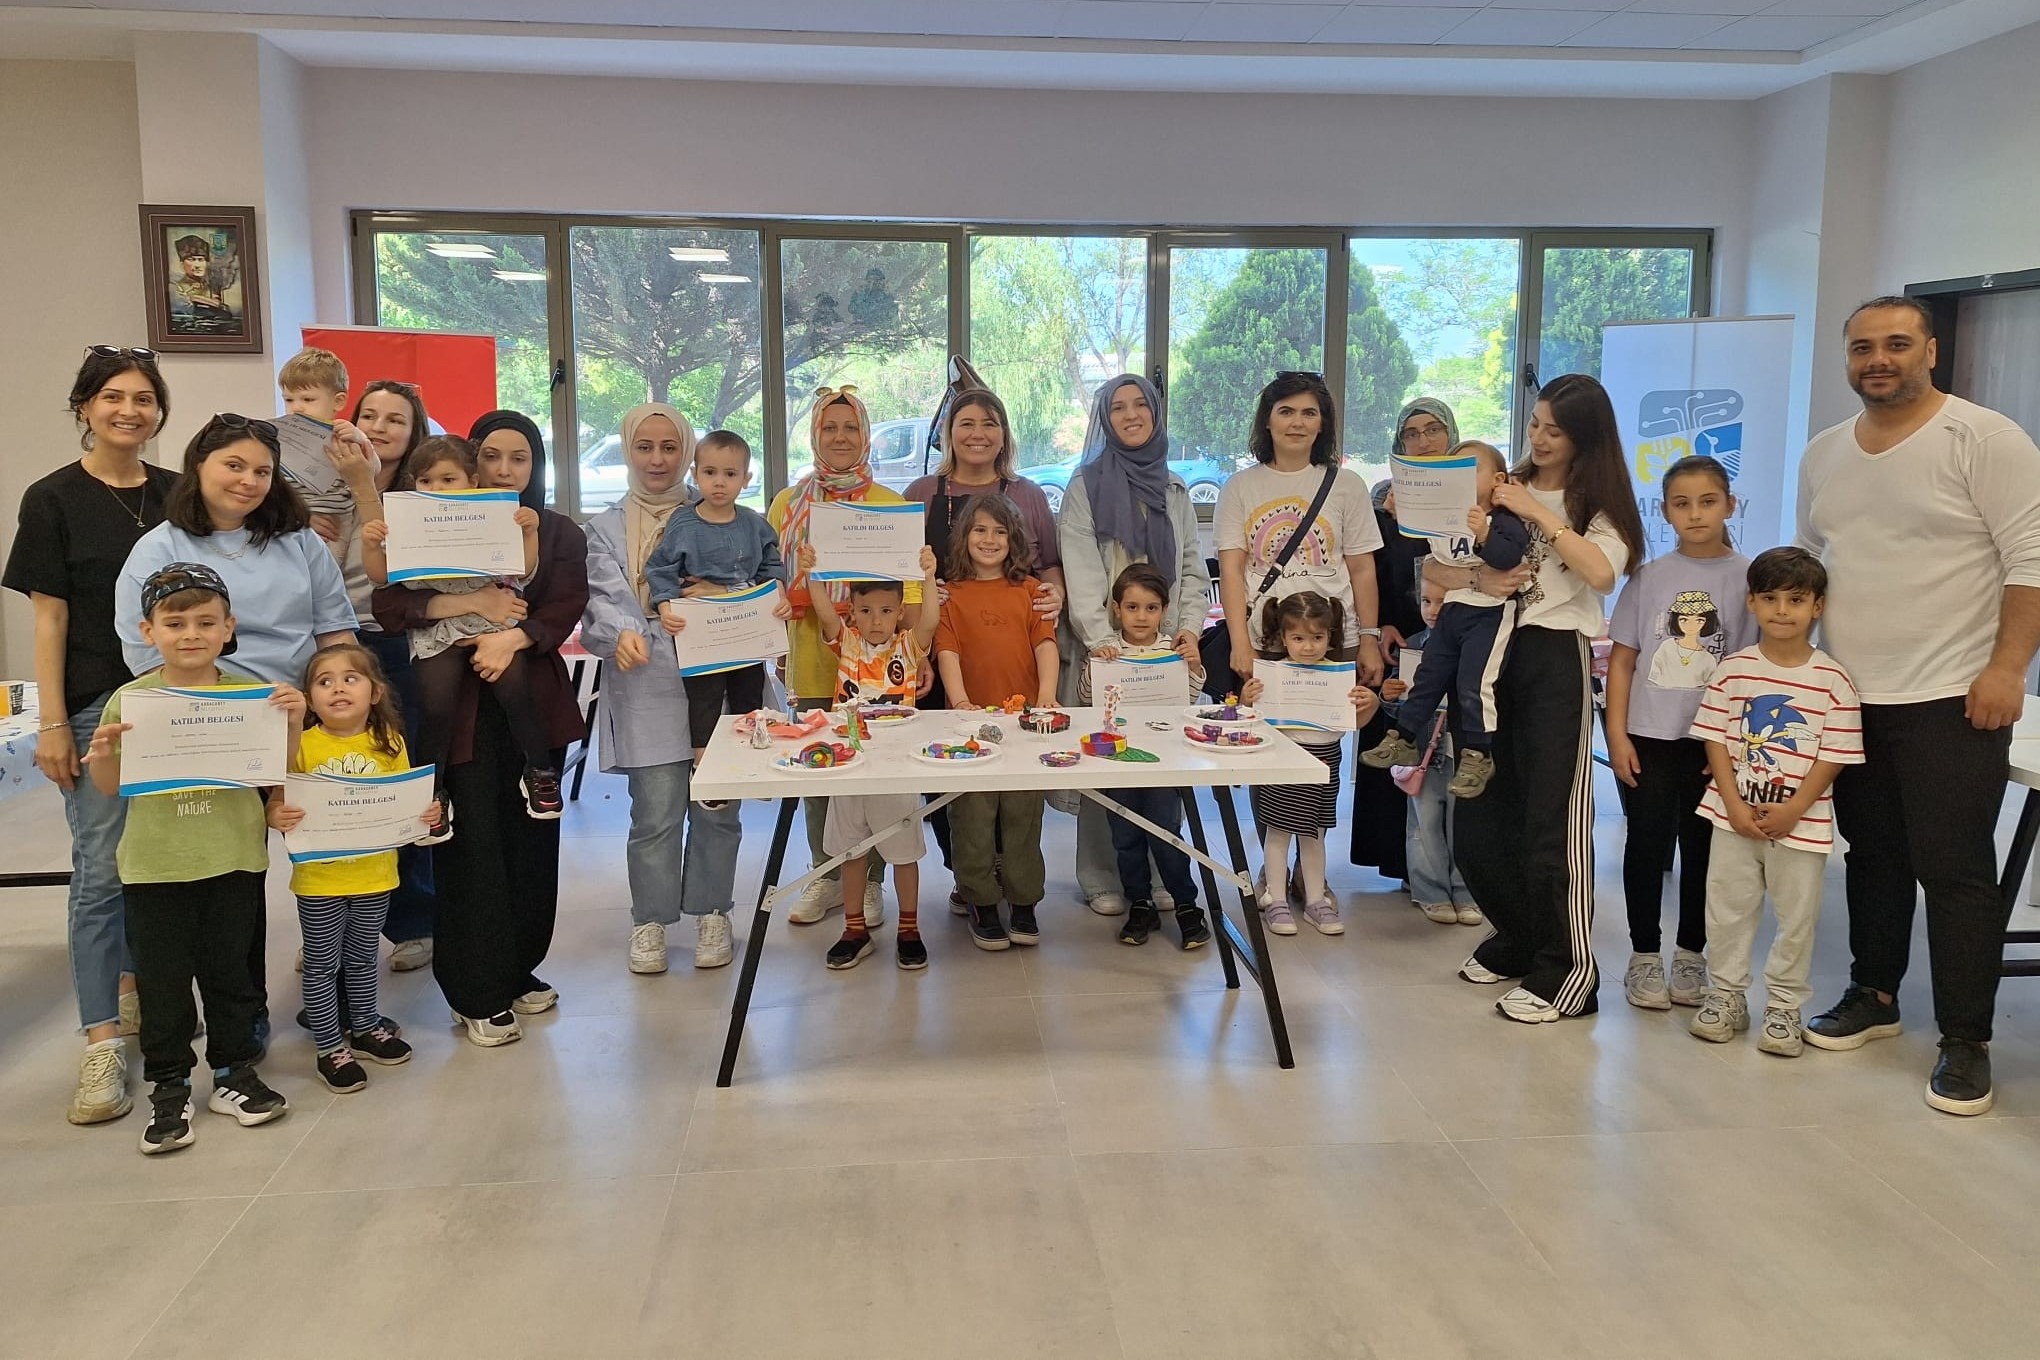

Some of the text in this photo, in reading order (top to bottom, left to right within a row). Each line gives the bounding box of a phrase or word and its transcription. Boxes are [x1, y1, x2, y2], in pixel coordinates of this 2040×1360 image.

[706, 616, 732, 625] KATILIM
[171, 713, 244, 726] KATILIM BELGESİ
[172, 789, 217, 800] SAVE THE
[328, 794, 396, 807] KATILIM BELGESİ
[177, 800, 212, 817] NATURE
